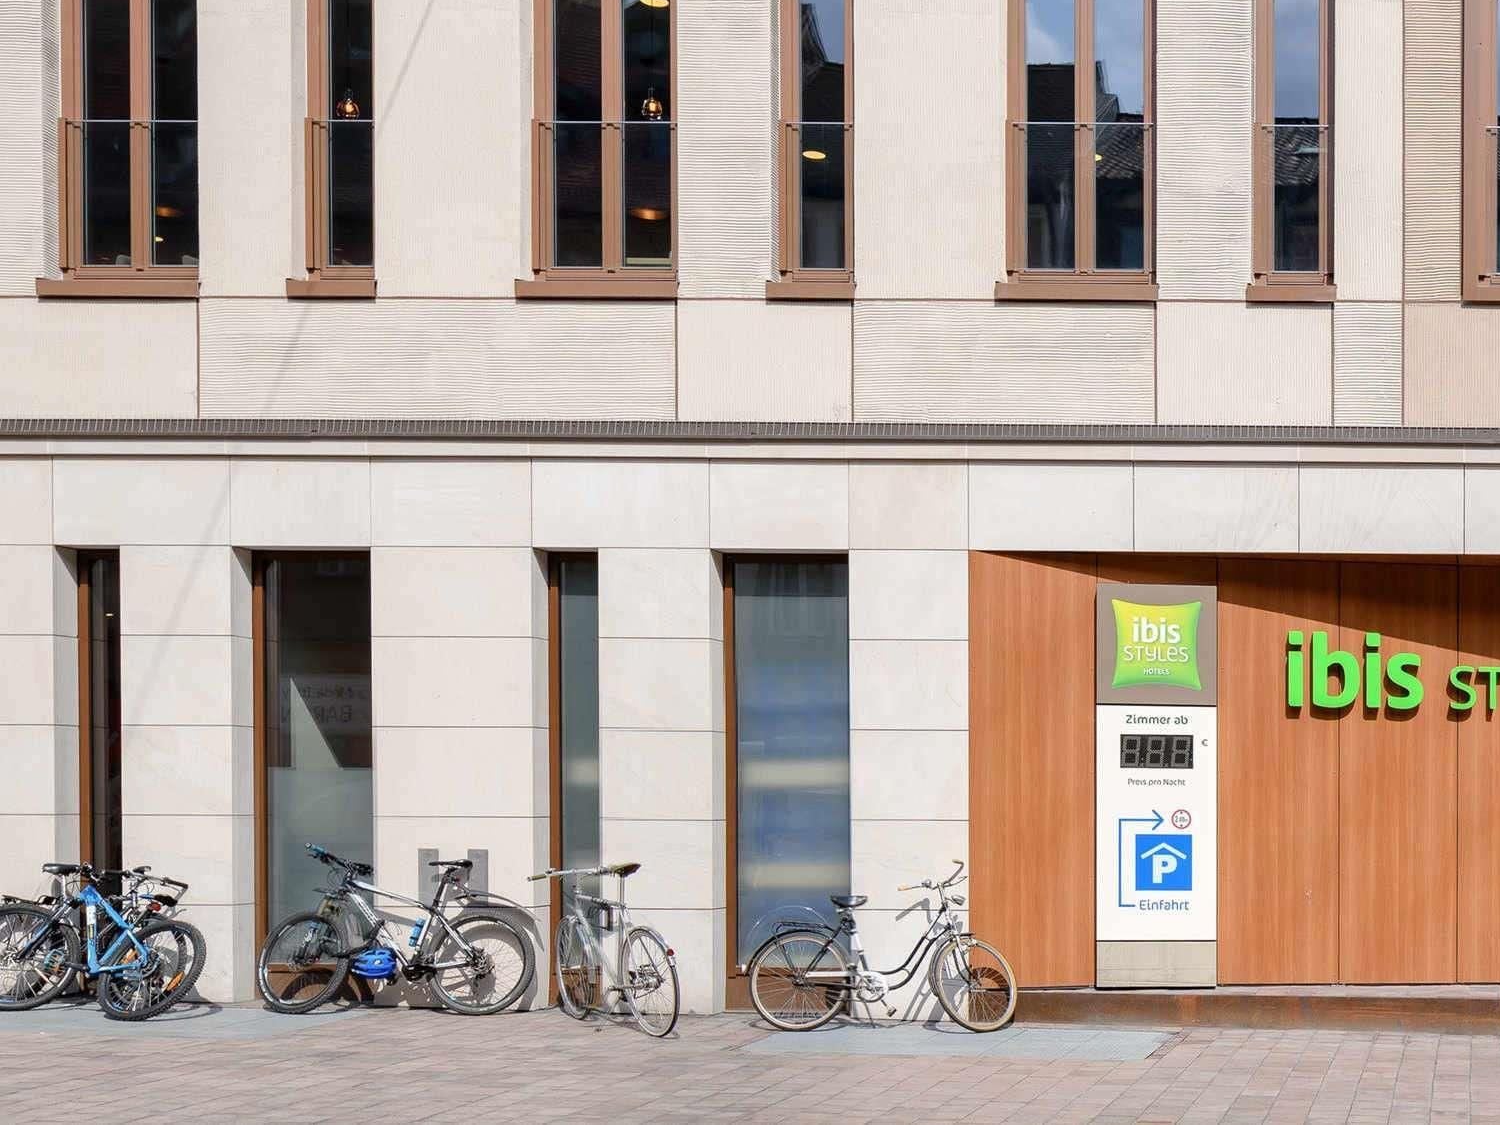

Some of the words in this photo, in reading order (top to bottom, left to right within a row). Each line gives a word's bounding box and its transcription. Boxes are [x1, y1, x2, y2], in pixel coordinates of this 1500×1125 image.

[1132, 616, 1181, 643] ibis
[1287, 630, 1424, 710] ibis
[1125, 714, 1171, 724] Zimmer
[1174, 715, 1189, 725] ab
[1127, 778, 1147, 786] Preis
[1148, 779, 1162, 788] pro
[1163, 778, 1187, 787] Nacht
[1152, 855, 1178, 883] P
[1139, 899, 1190, 911] Einfahrt
